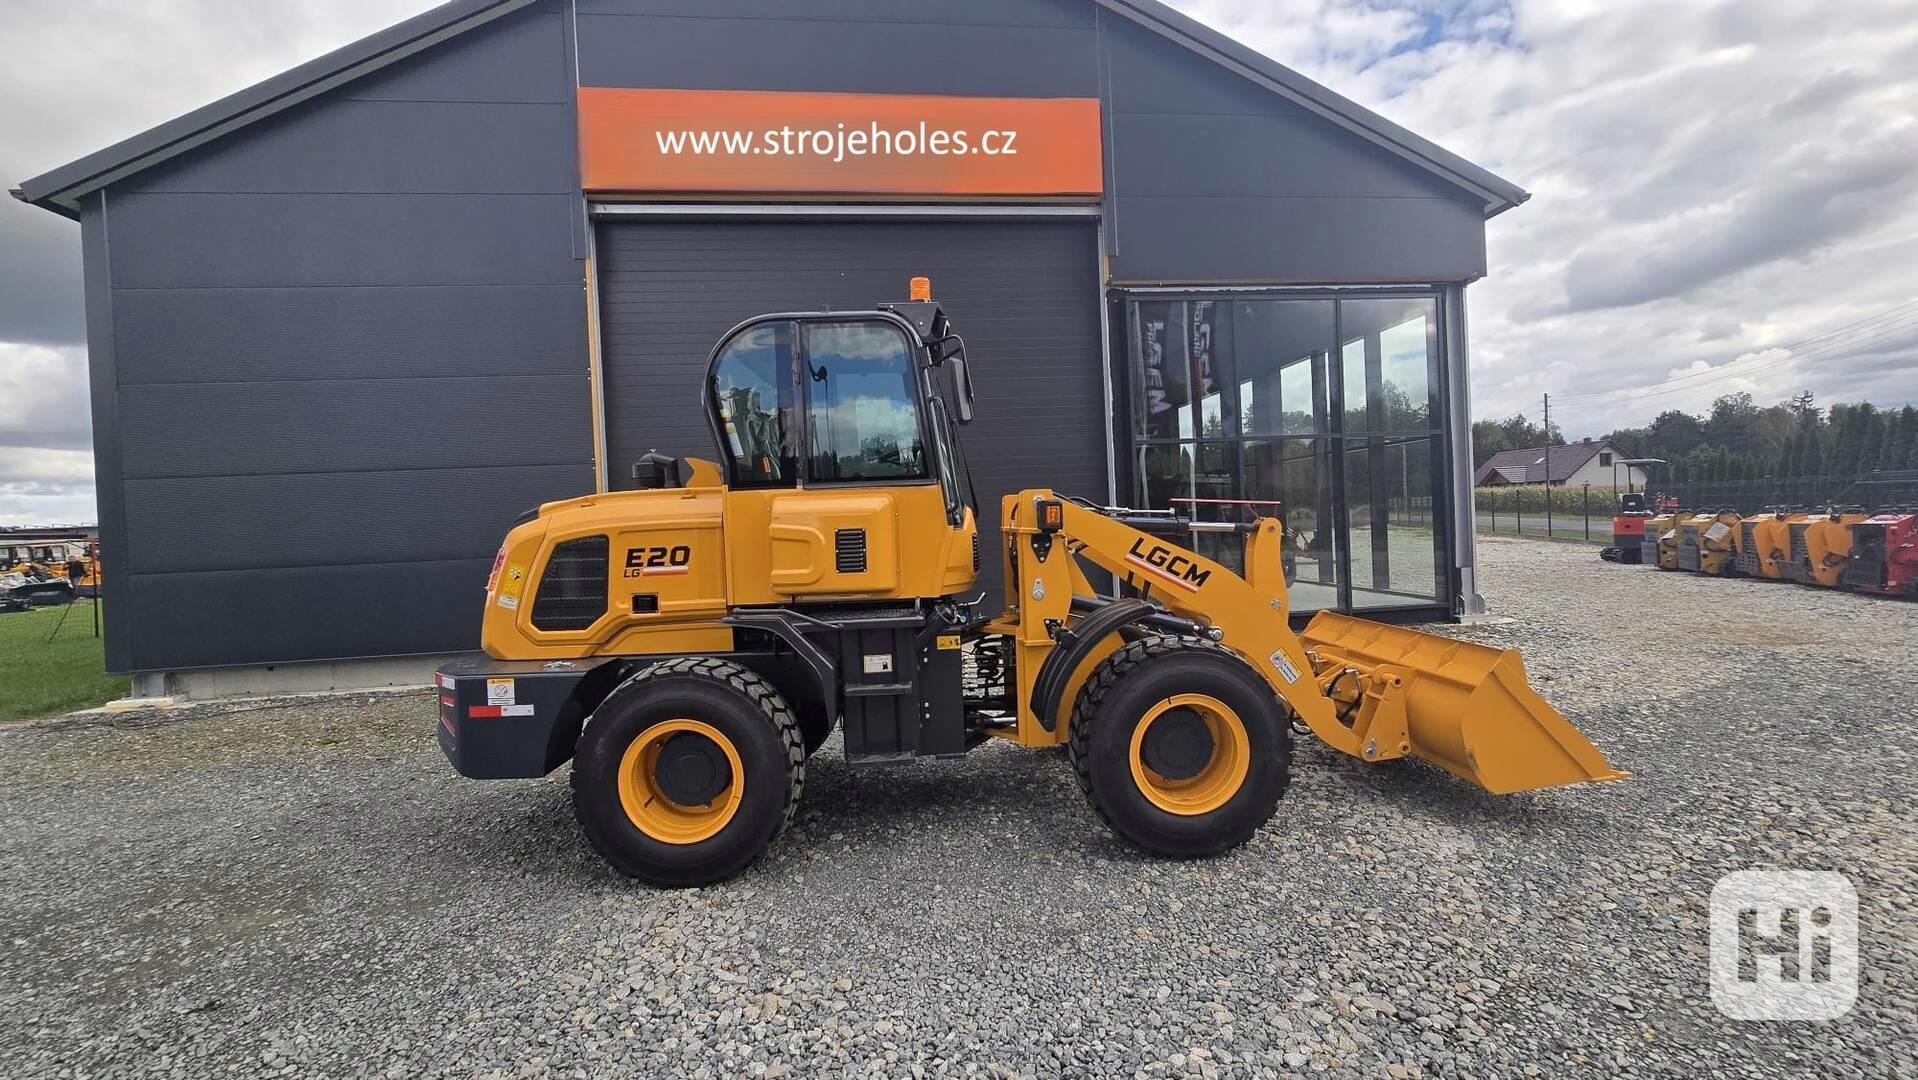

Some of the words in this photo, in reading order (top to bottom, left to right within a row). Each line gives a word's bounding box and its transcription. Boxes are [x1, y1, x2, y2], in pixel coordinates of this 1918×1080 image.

[655, 121, 1017, 162] www.strojeholes.cz
[625, 545, 691, 568] E20
[1129, 537, 1212, 588] LGCM
[623, 568, 641, 578] LG
